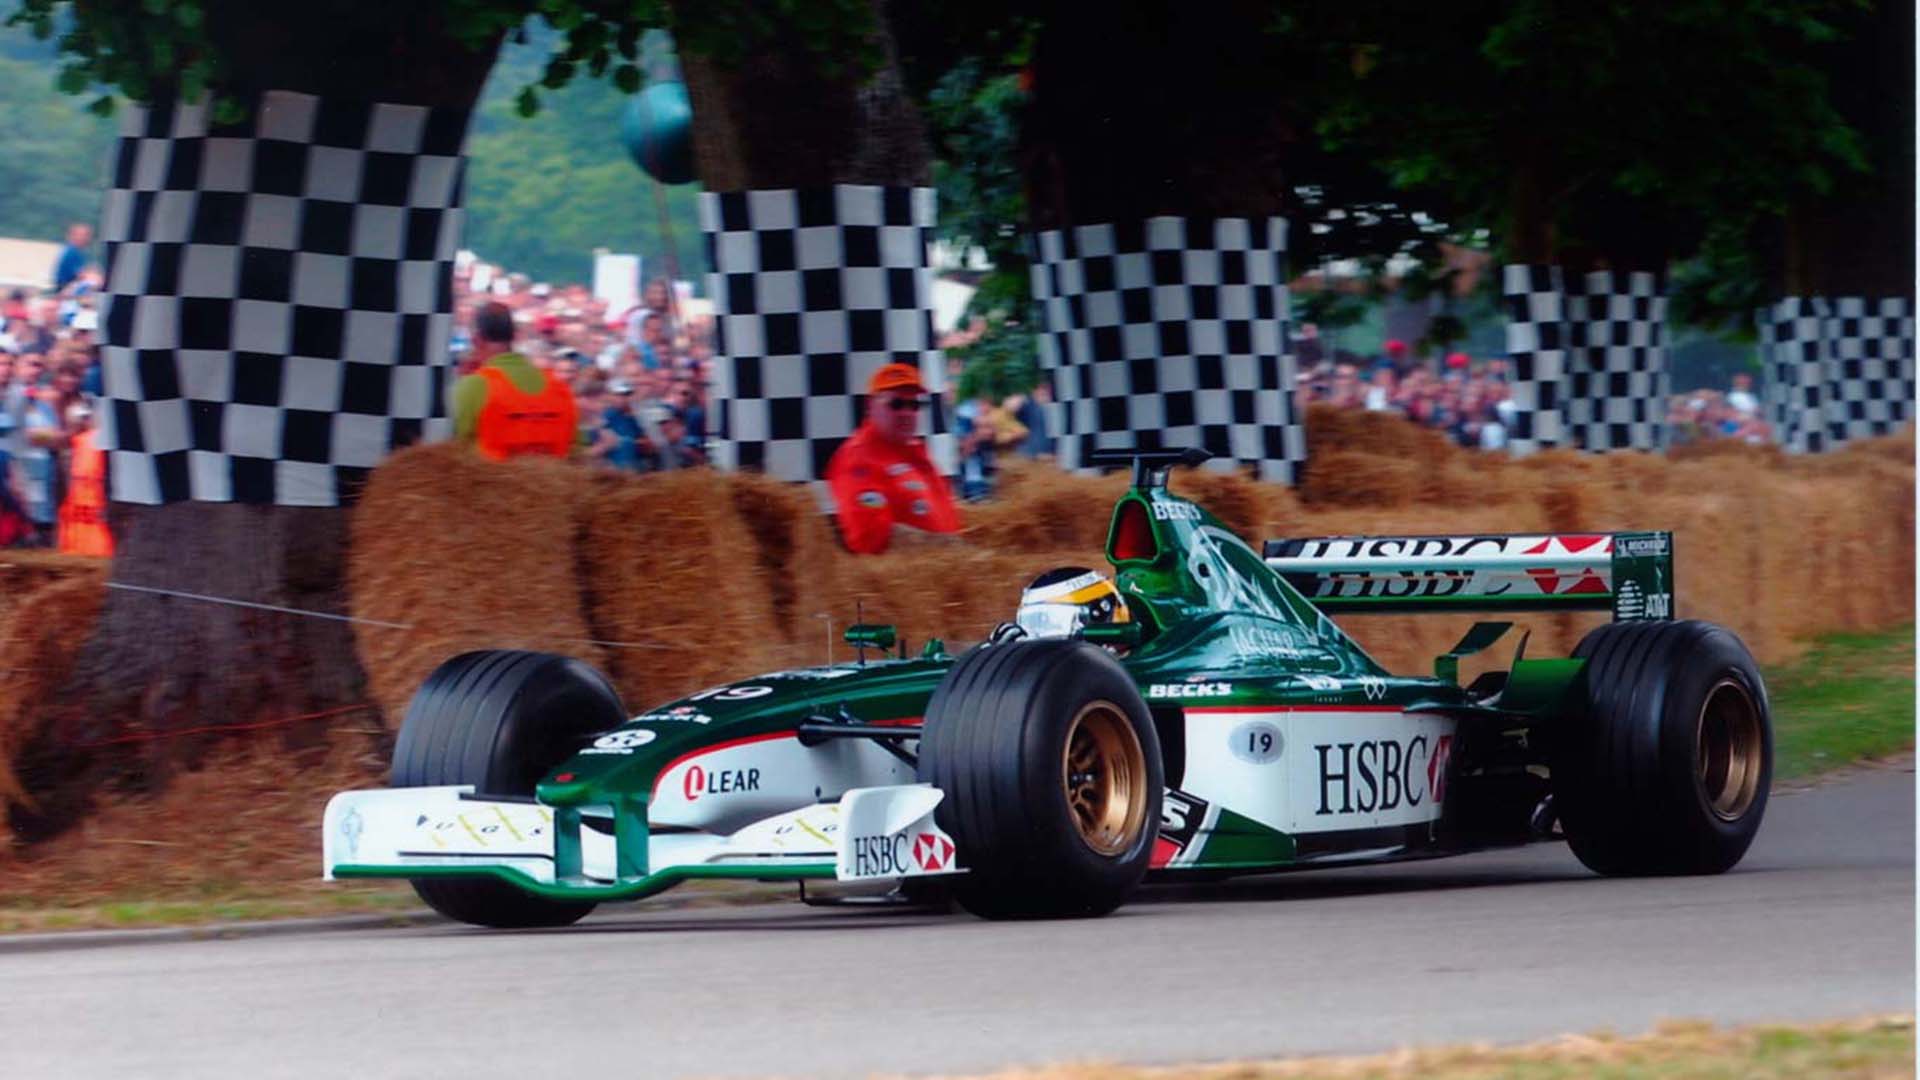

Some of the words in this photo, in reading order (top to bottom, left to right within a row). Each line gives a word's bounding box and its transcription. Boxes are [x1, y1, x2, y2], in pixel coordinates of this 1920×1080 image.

[1249, 732, 1273, 754] 19
[708, 768, 760, 794] LEAR
[1313, 736, 1428, 815] HSBC
[855, 833, 908, 876] HSBC
